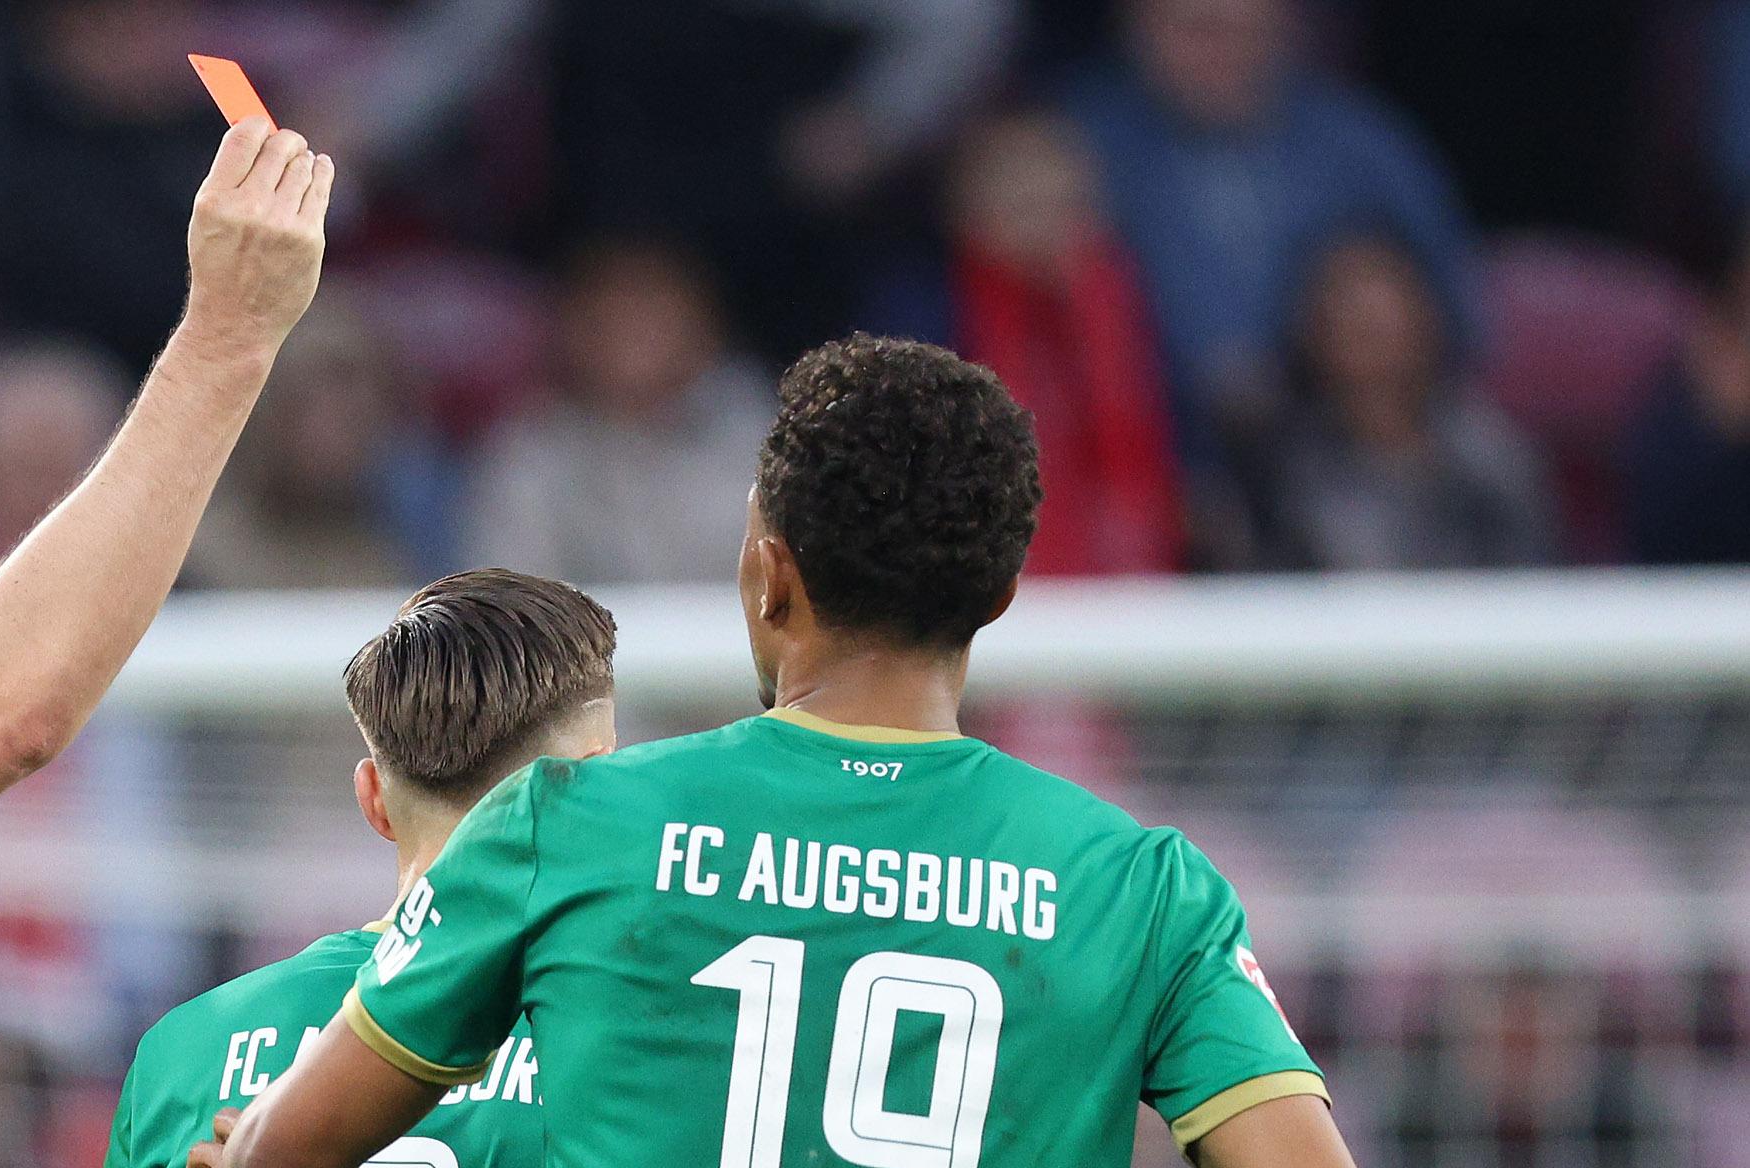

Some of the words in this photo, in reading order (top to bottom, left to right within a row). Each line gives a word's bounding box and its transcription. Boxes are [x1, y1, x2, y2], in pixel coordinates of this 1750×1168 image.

[840, 759, 904, 781] 1907
[656, 822, 725, 896] FC
[737, 832, 1058, 941] AUGSBURG
[218, 1026, 278, 1101] FC
